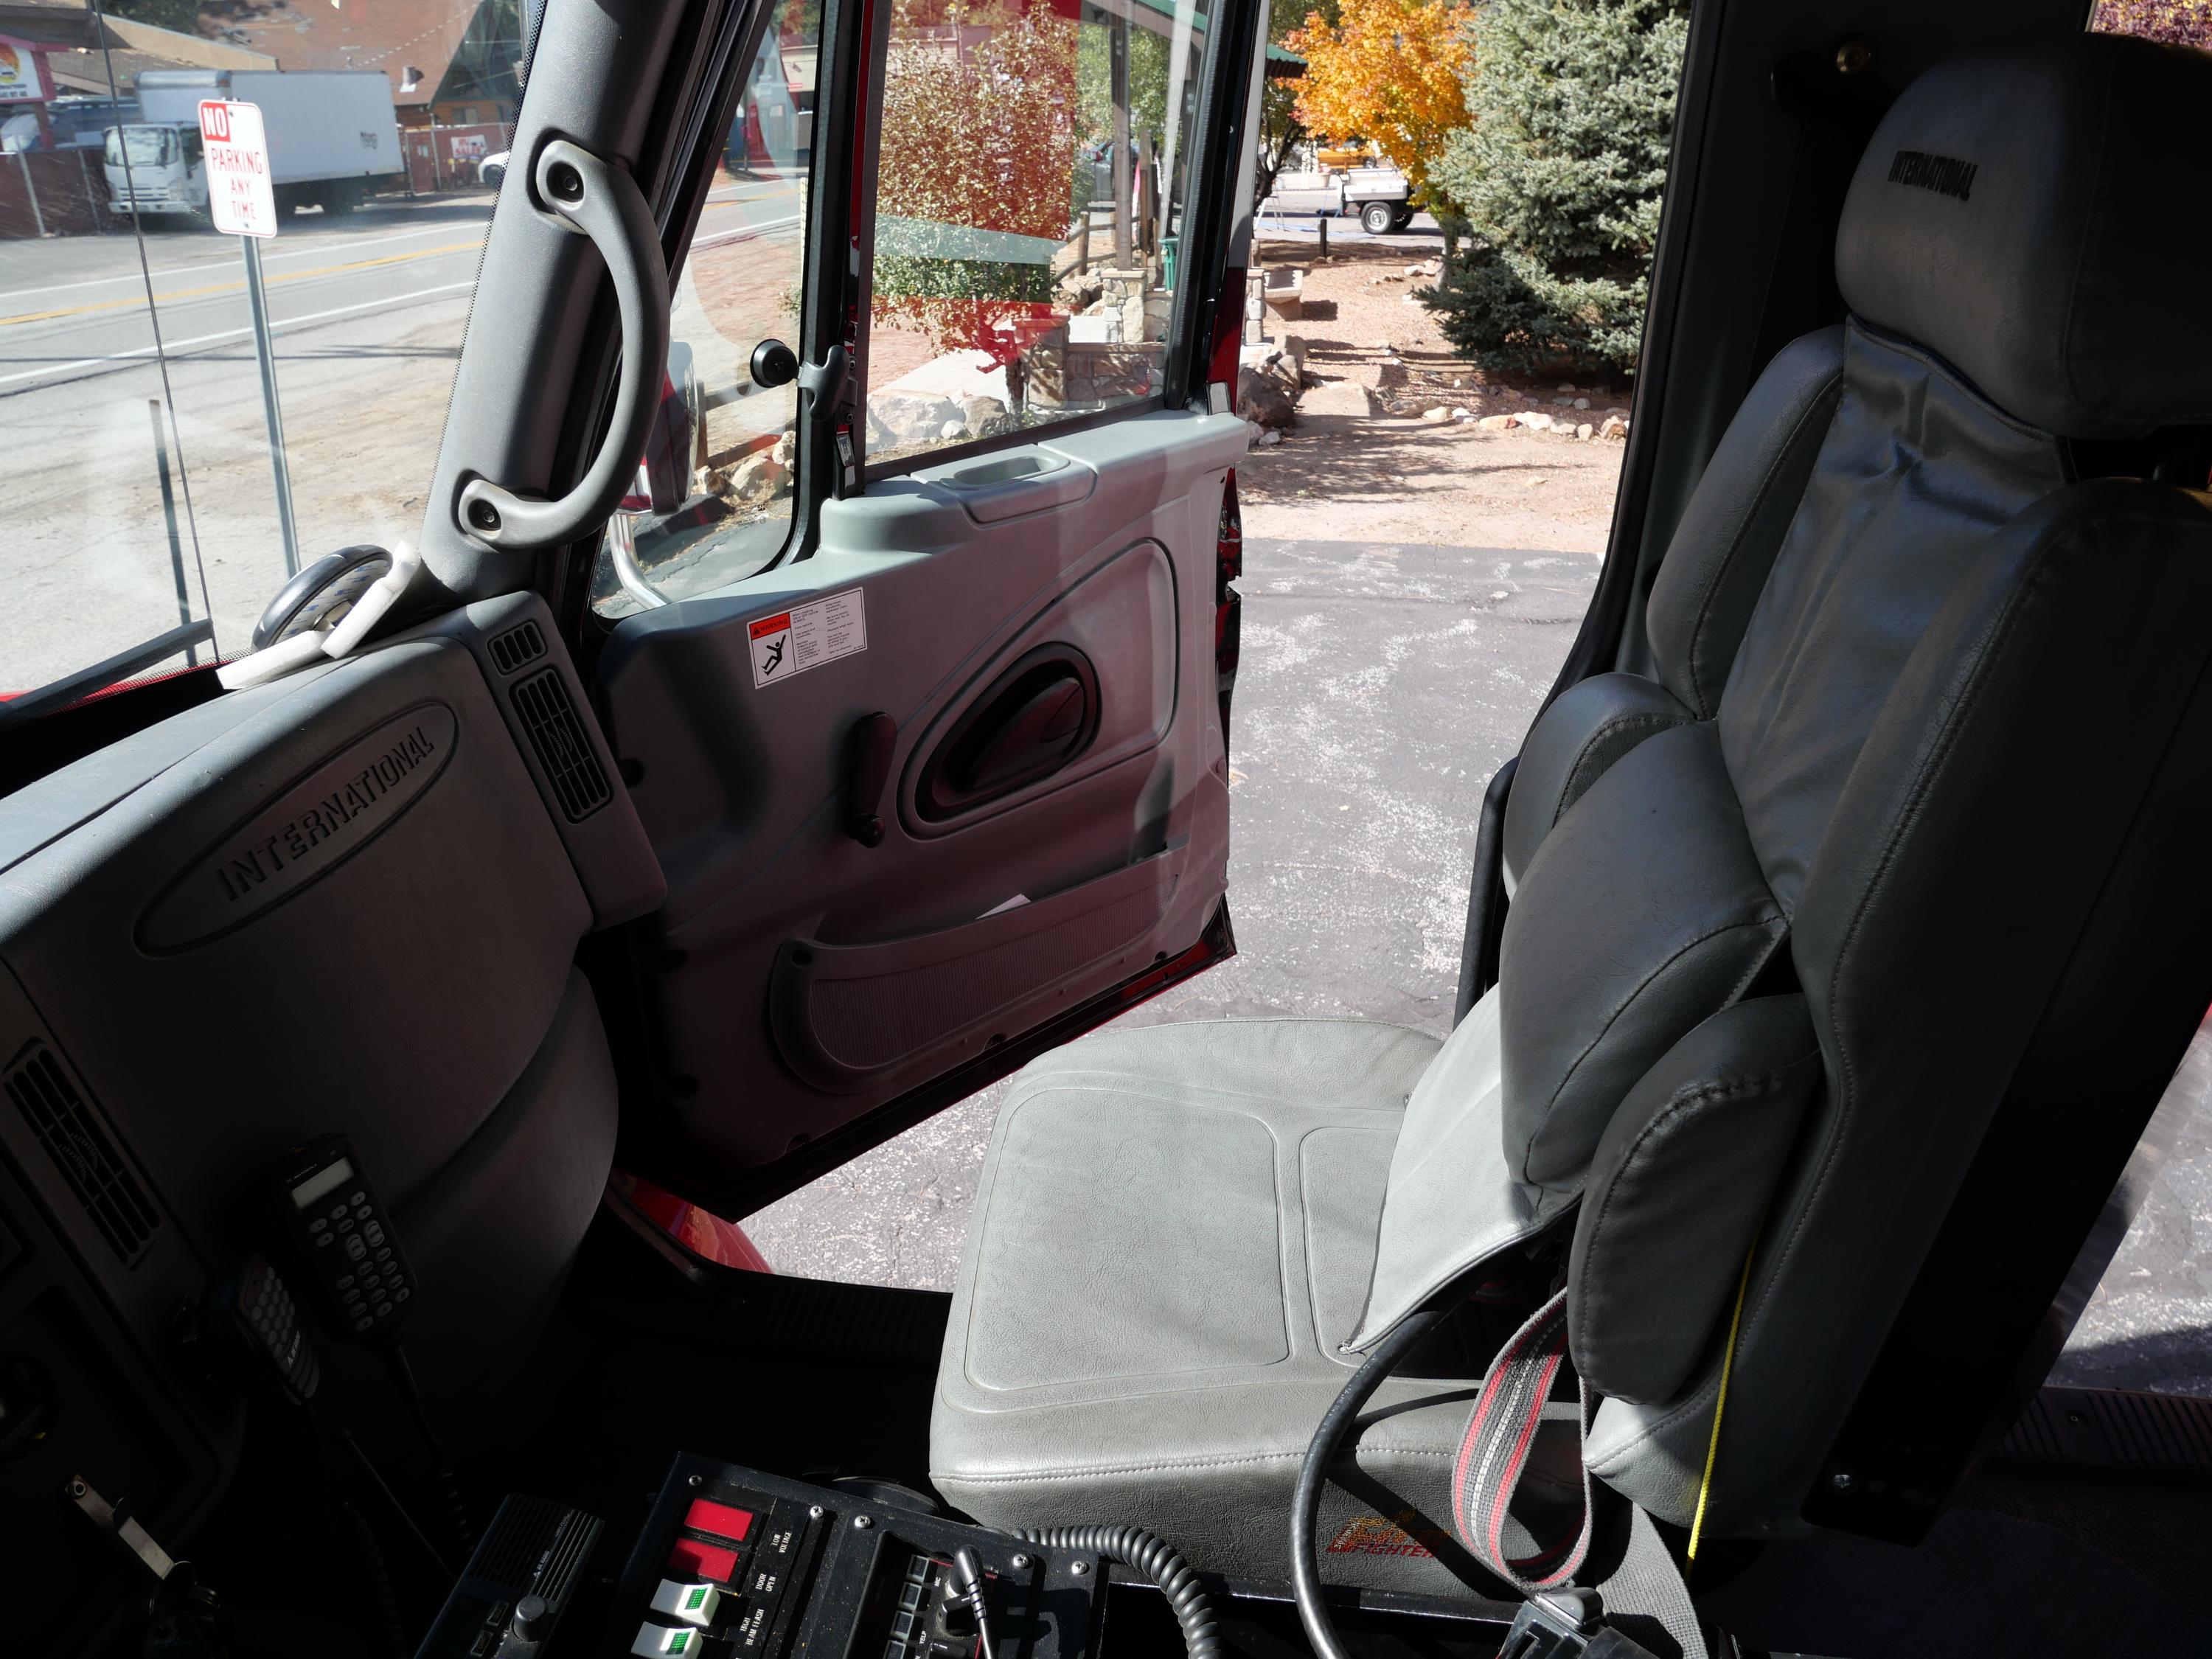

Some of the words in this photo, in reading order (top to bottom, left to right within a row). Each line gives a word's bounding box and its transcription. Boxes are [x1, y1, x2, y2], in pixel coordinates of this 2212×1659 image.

[202, 107, 229, 138] NO
[211, 147, 263, 175] PARKING
[1887, 150, 1978, 202] INTERNATIONAL
[231, 178, 251, 195] ANY
[232, 201, 257, 220] TIME
[759, 618, 788, 632] WARNING
[216, 726, 435, 902] INTERNATIONAL
[771, 1533, 782, 1547] LOW
[778, 1530, 793, 1554] VOLTAGE
[755, 1573, 768, 1590] DOOR
[765, 1576, 776, 1593] OPEN
[933, 1576, 942, 1587] MIC
[740, 1617, 751, 1632] HIGH
[745, 1628, 758, 1646] BEAM
[752, 1608, 765, 1629] FLASH
[919, 1630, 928, 1645] YELP
